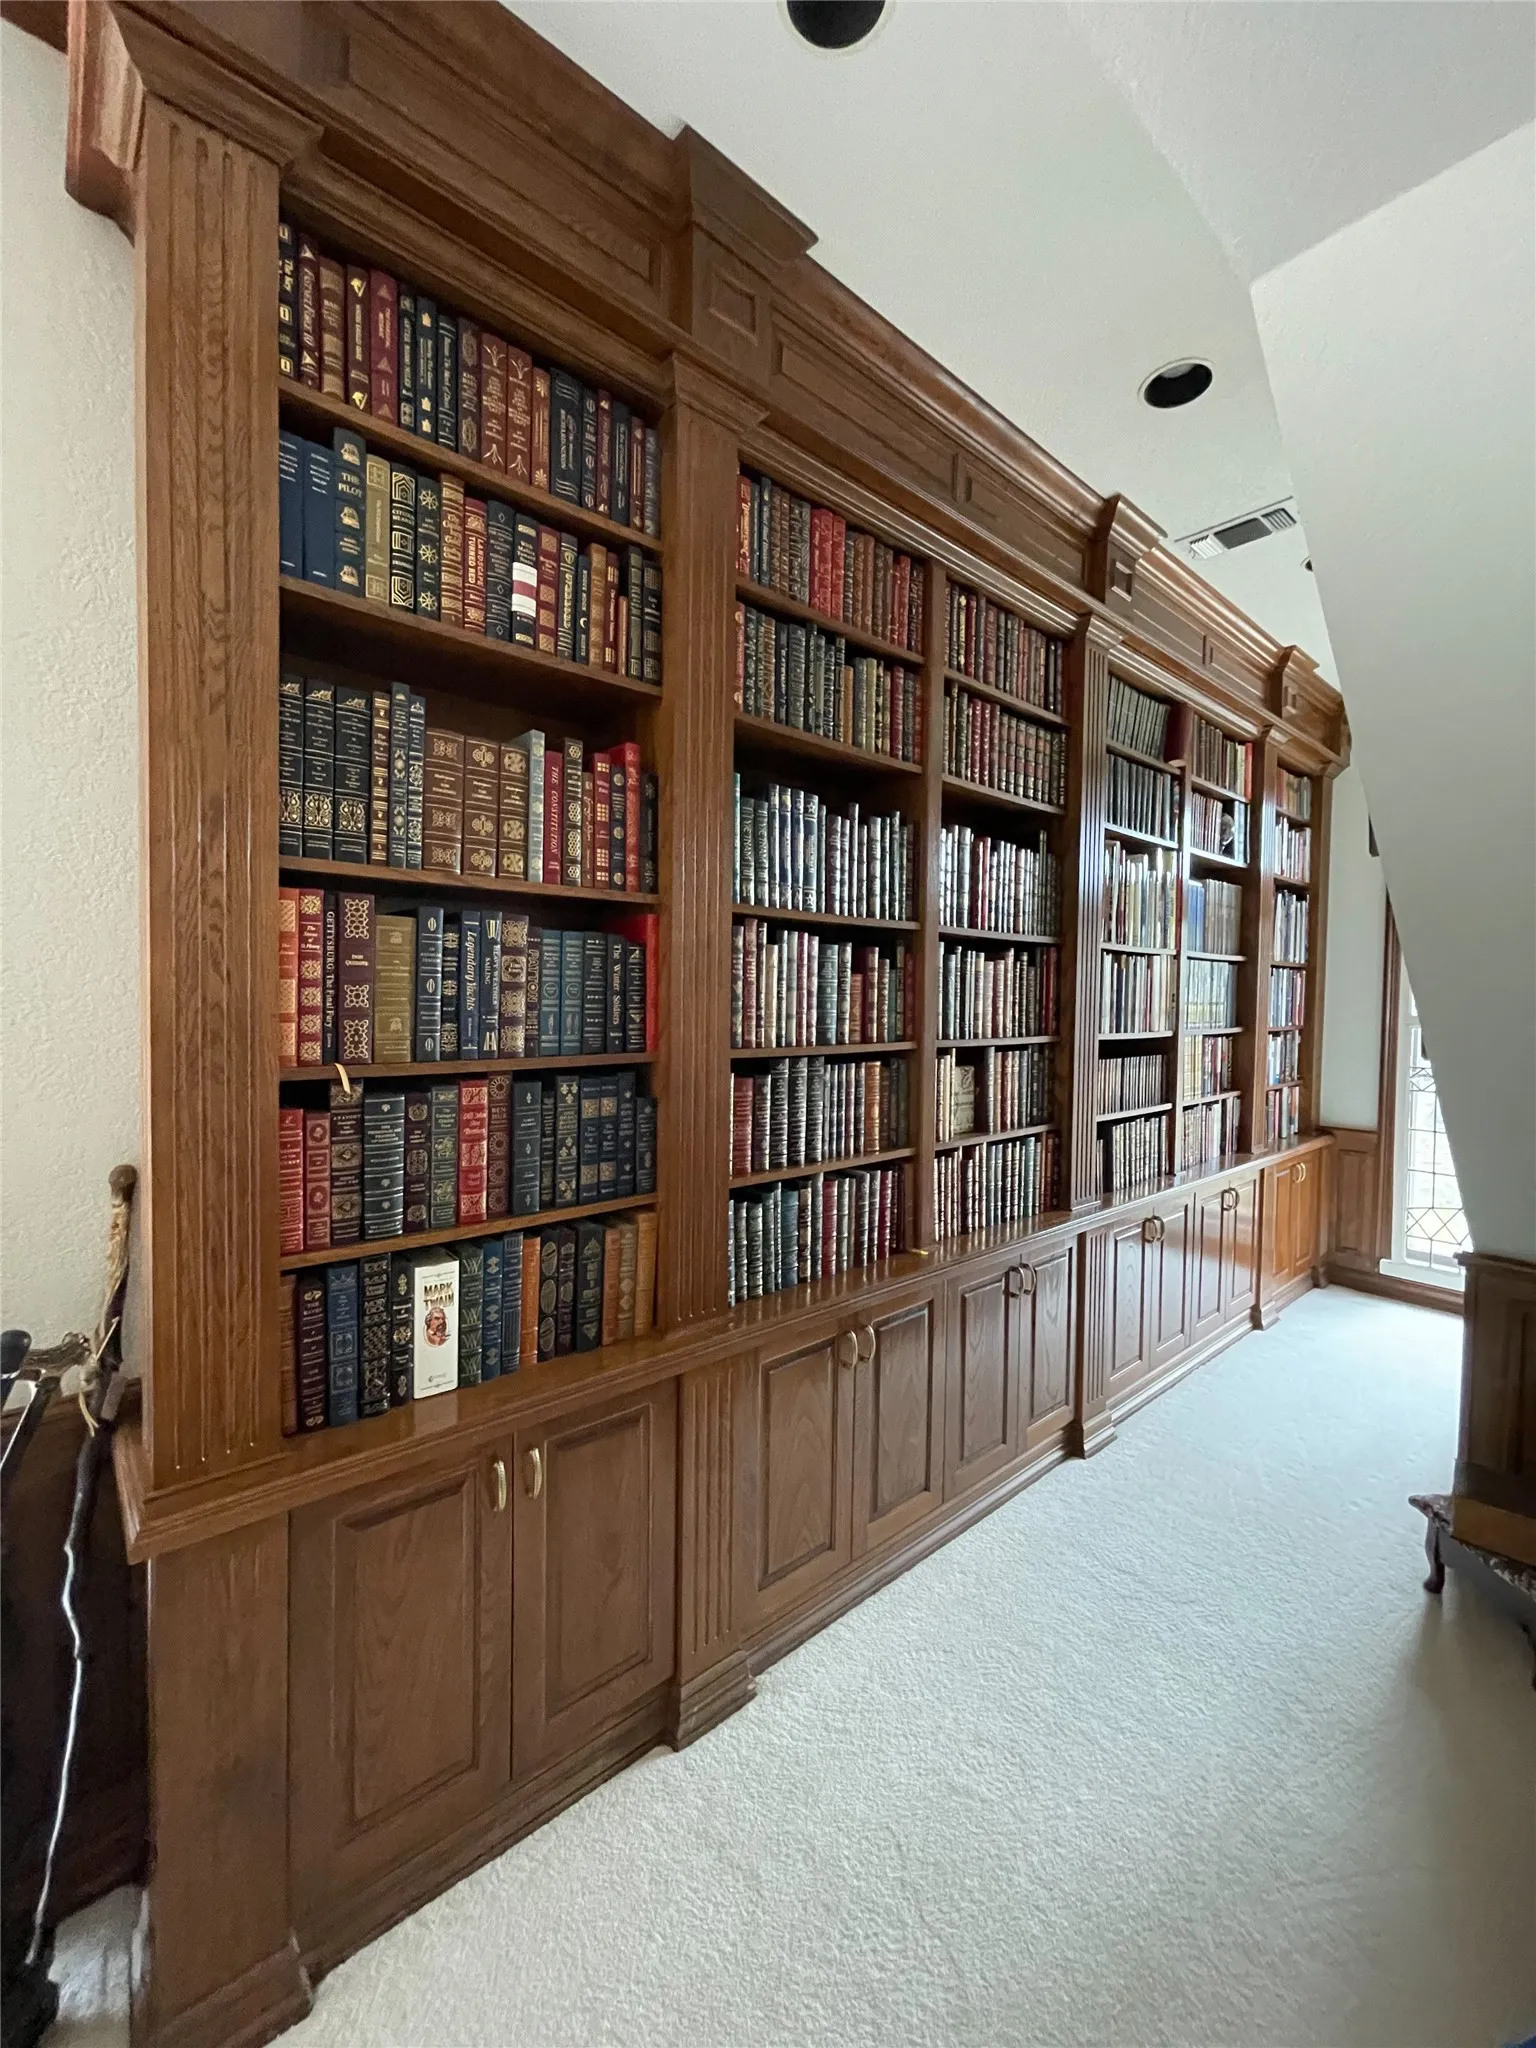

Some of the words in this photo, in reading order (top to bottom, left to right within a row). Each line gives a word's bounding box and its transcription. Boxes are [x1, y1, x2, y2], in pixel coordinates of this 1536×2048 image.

[341, 471, 360, 485] THE
[338, 482, 363, 499] PILOT
[468, 536, 476, 566] TURNED
[477, 538, 485, 587] LANDSCAPE
[468, 567, 476, 583] RED
[551, 765, 559, 785] THE
[550, 790, 559, 854] CONSTITUTION
[464, 931, 477, 981] Legendary
[613, 943, 621, 959] The
[326, 974, 335, 988] The
[527, 949, 540, 1003] PATTON
[613, 963, 621, 991] Winter
[326, 989, 335, 1008] Final
[466, 981, 477, 1011] Yachts
[324, 1010, 335, 1028] Fury
[613, 995, 621, 1025] Soldiers
[423, 1281, 454, 1297] MARK
[422, 1292, 455, 1310] TWAIN
